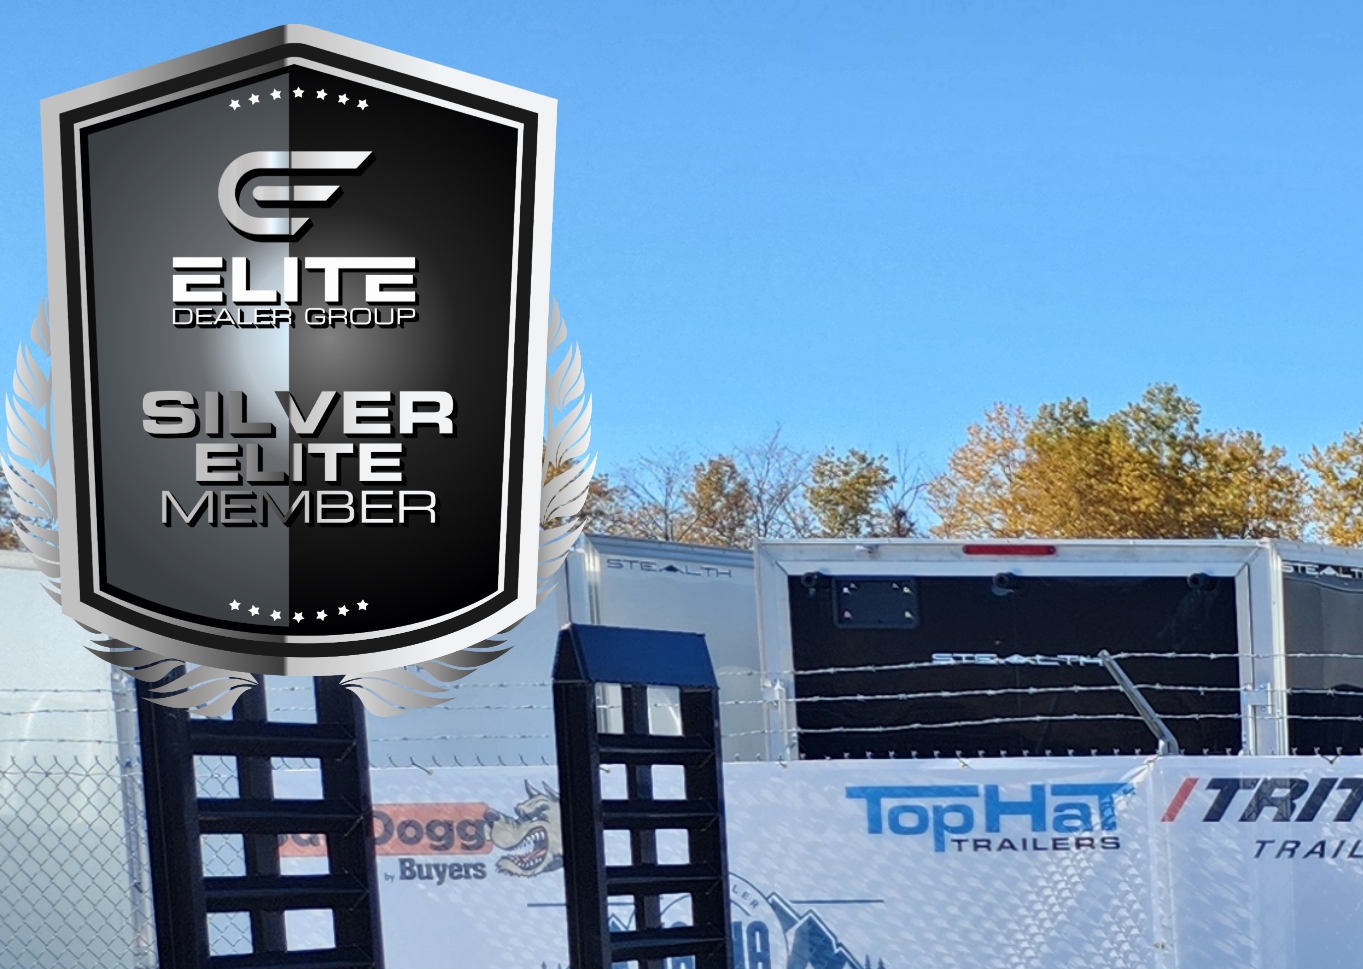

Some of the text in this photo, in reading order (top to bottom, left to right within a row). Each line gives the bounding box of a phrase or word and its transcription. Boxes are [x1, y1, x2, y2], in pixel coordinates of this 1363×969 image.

[606, 558, 733, 579] STEALTH
[951, 836, 1121, 852] TRAILERS
[398, 857, 487, 886] Buyers
